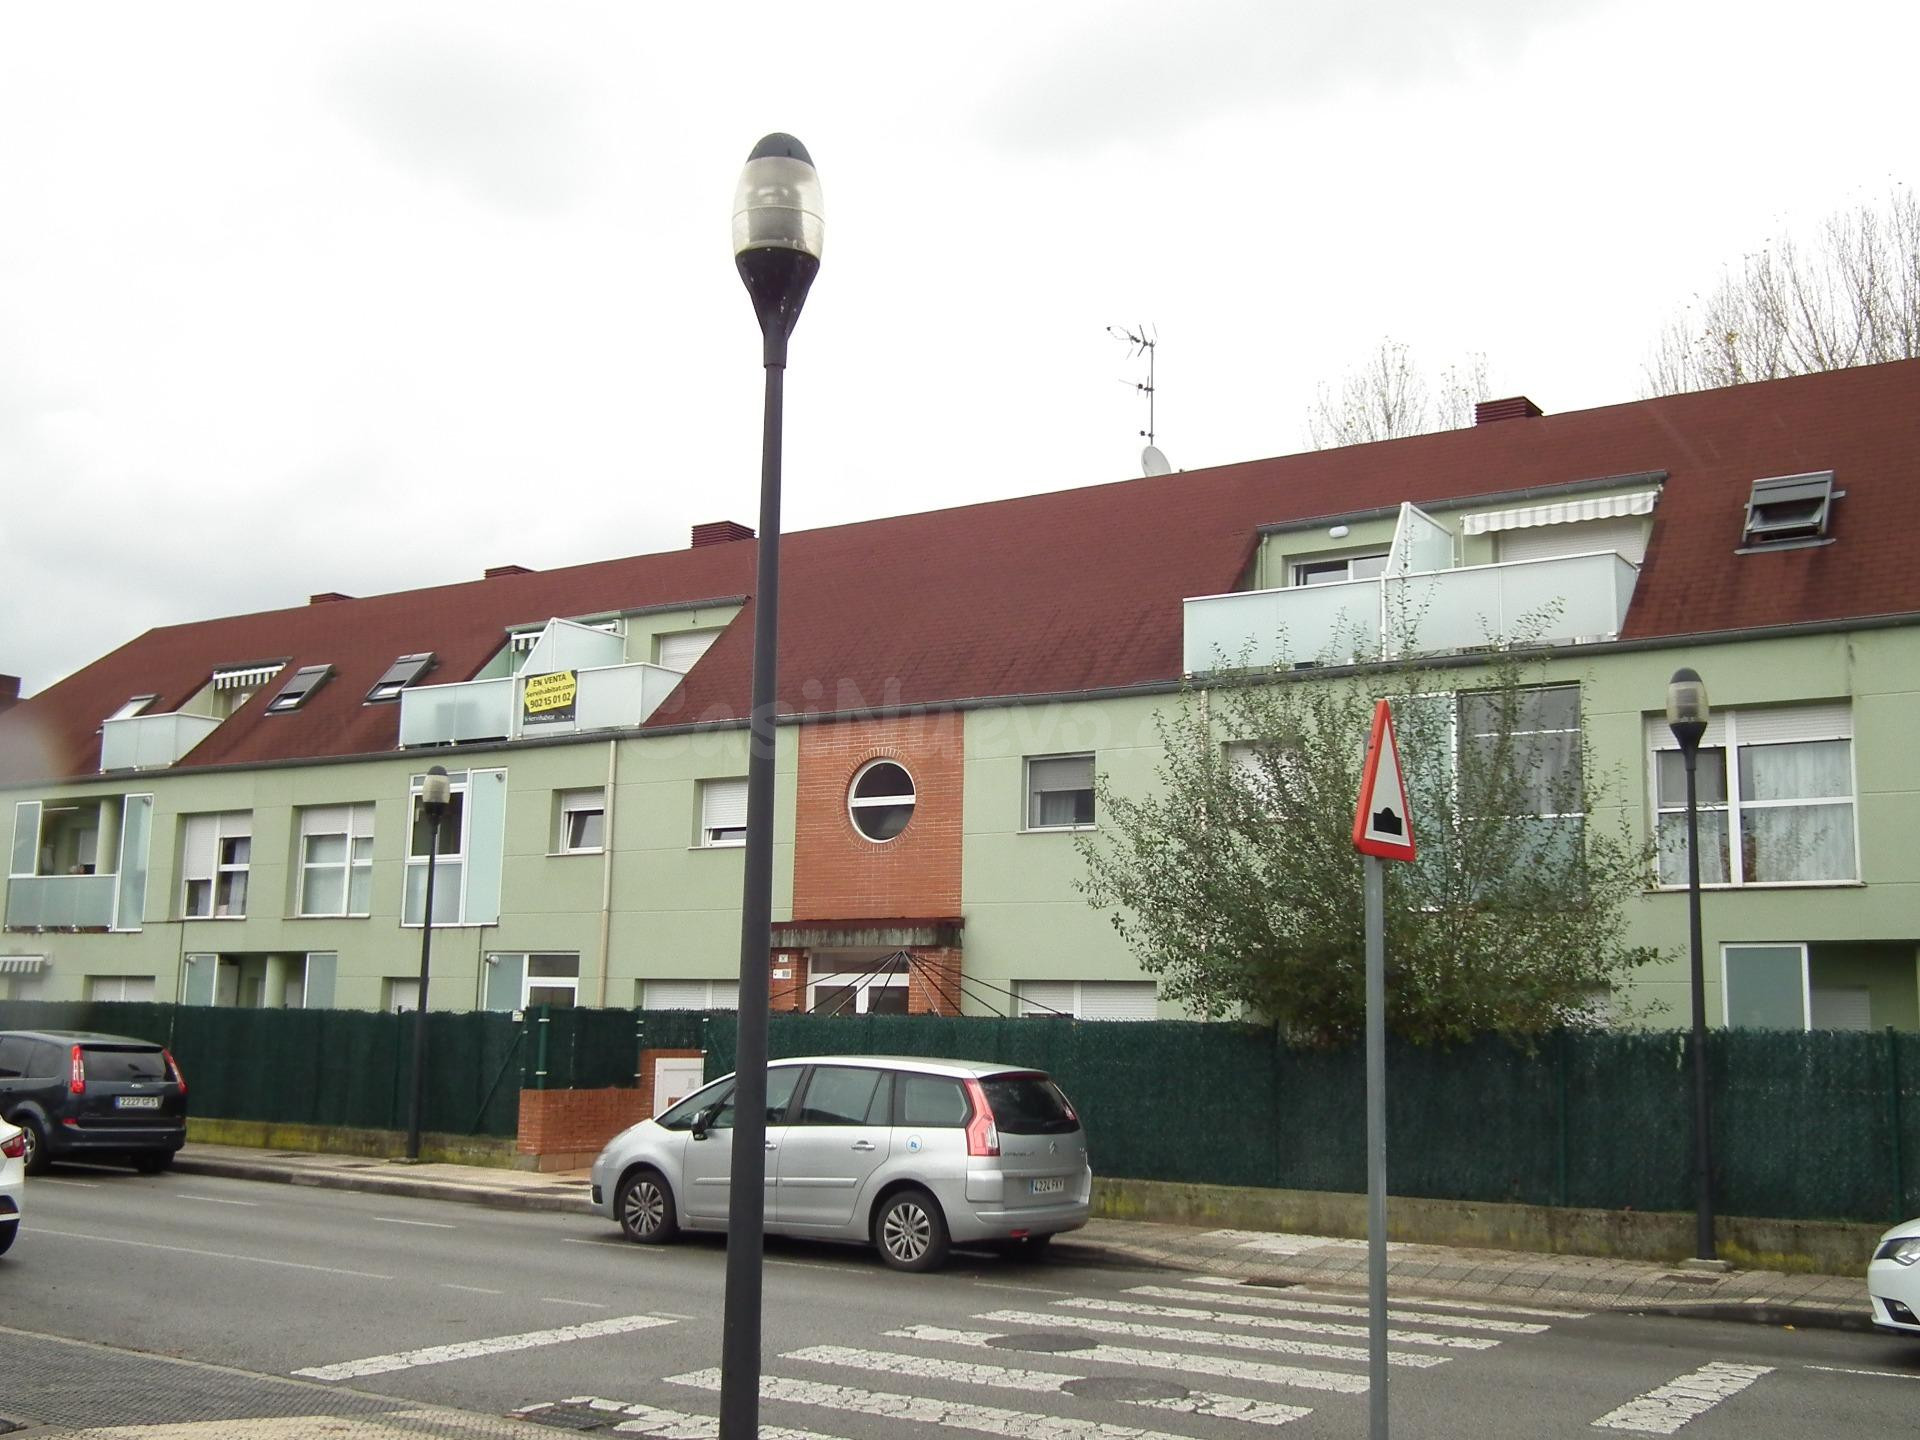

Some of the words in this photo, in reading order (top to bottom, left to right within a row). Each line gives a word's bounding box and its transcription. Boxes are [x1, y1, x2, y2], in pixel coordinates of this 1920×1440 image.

[544, 674, 567, 684] VENTA
[530, 698, 543, 708] 902
[544, 697, 551, 705] 15
[553, 694, 561, 703] 01
[562, 692, 571, 702] 02
